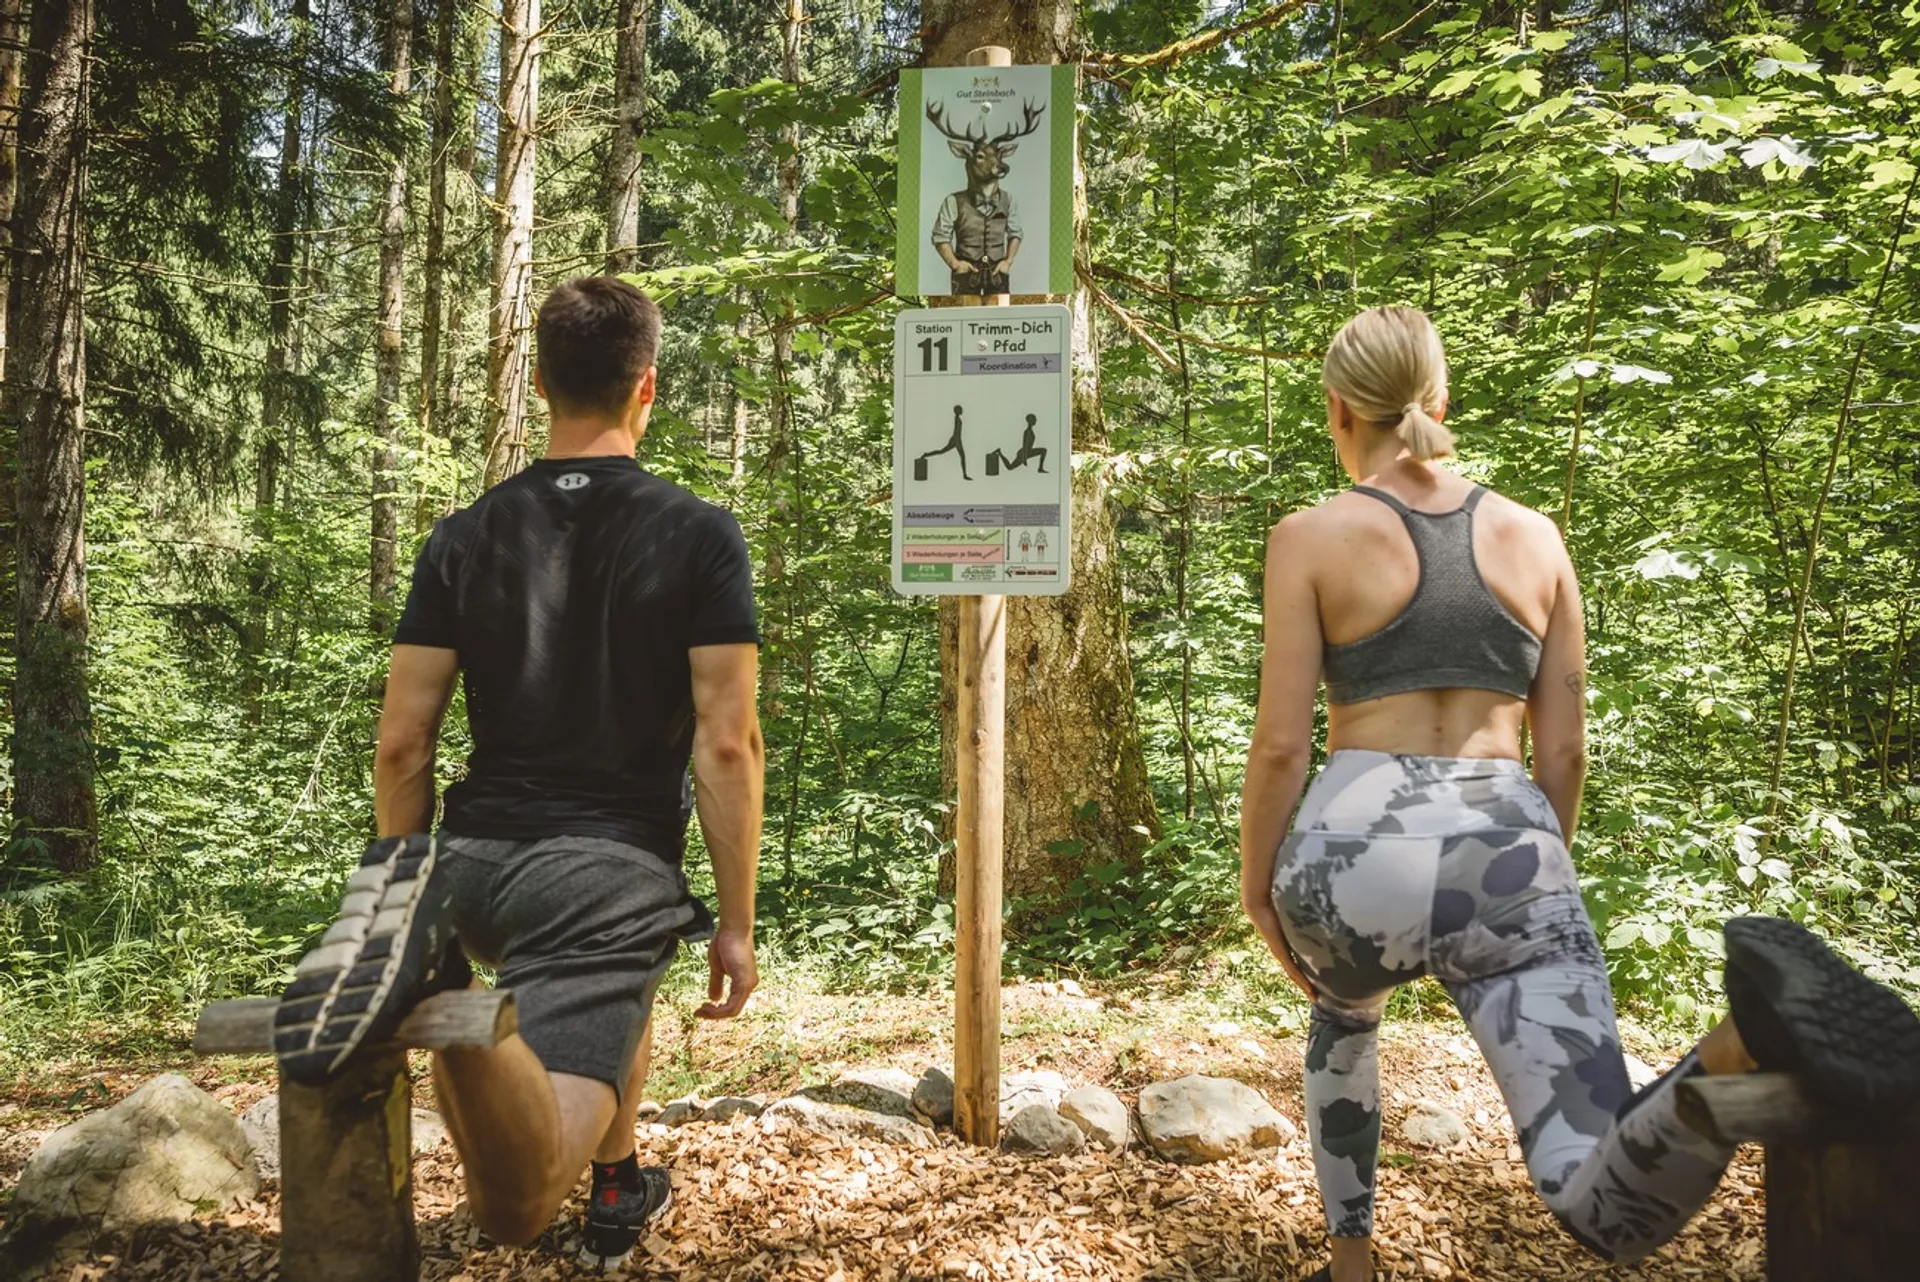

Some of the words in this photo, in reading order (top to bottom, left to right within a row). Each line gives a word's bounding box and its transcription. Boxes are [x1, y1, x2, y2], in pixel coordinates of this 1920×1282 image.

[956, 90, 972, 98] Gut
[973, 88, 1016, 98] Steinbach
[915, 323, 953, 334] Station
[967, 321, 1053, 335] Trimm-Dich
[993, 339, 1026, 352] Pfad
[917, 337, 948, 372] 11
[979, 361, 1037, 371] Koordination
[906, 511, 955, 520] Absatzbeuge
[912, 533, 958, 542] Wiederholungen
[912, 551, 958, 559] Wiederholungen
